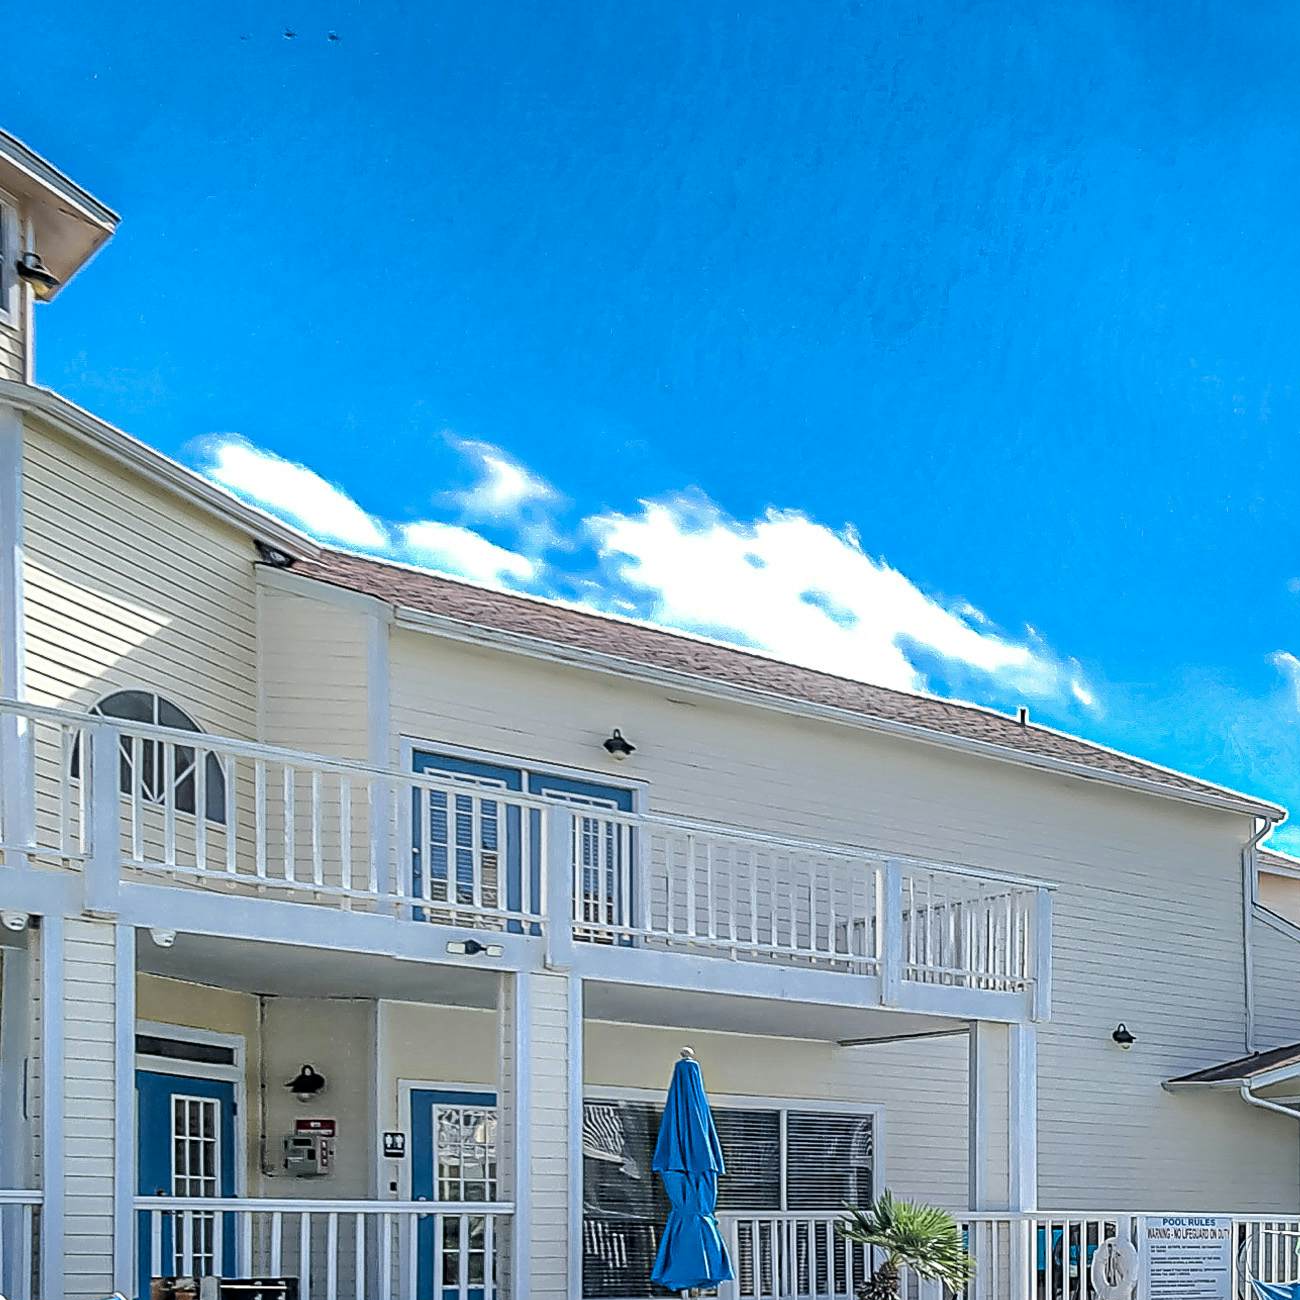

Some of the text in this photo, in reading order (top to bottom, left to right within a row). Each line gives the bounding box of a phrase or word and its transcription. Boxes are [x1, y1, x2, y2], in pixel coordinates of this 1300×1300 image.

[1162, 1218, 1216, 1226] POOL RULES
[1147, 1227, 1170, 1240] WARNING
[1174, 1227, 1182, 1240] NO
[1182, 1227, 1209, 1240] LIFEGUARD
